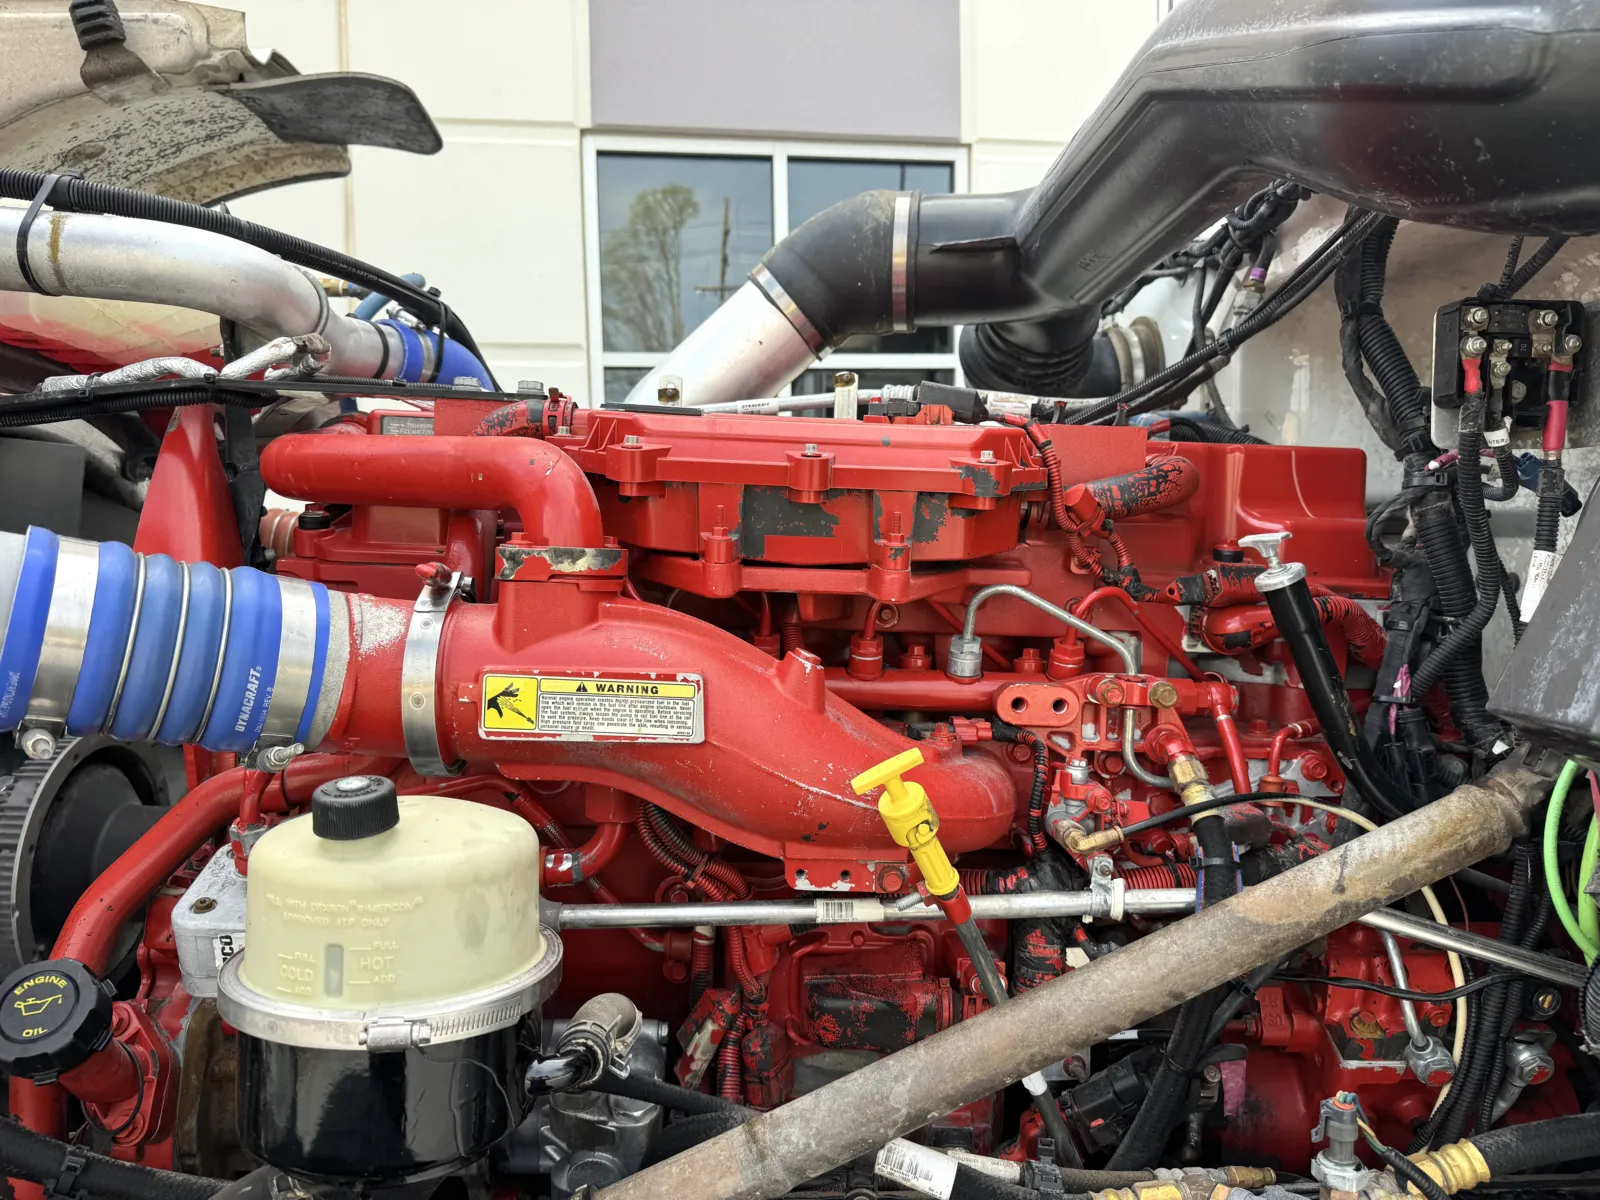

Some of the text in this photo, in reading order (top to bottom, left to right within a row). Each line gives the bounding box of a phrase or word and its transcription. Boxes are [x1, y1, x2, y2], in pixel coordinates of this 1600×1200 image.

[596, 684, 658, 694] WARNING
[335, 917, 356, 927] ATF
[361, 916, 390, 928] ONLY
[373, 941, 400, 950] FULL
[294, 952, 316, 963] FULL
[360, 956, 394, 970] HOT
[280, 964, 314, 982] COLD
[372, 974, 396, 984] ADD
[14, 976, 68, 996] ENGINE
[22, 1027, 48, 1037] OIL
